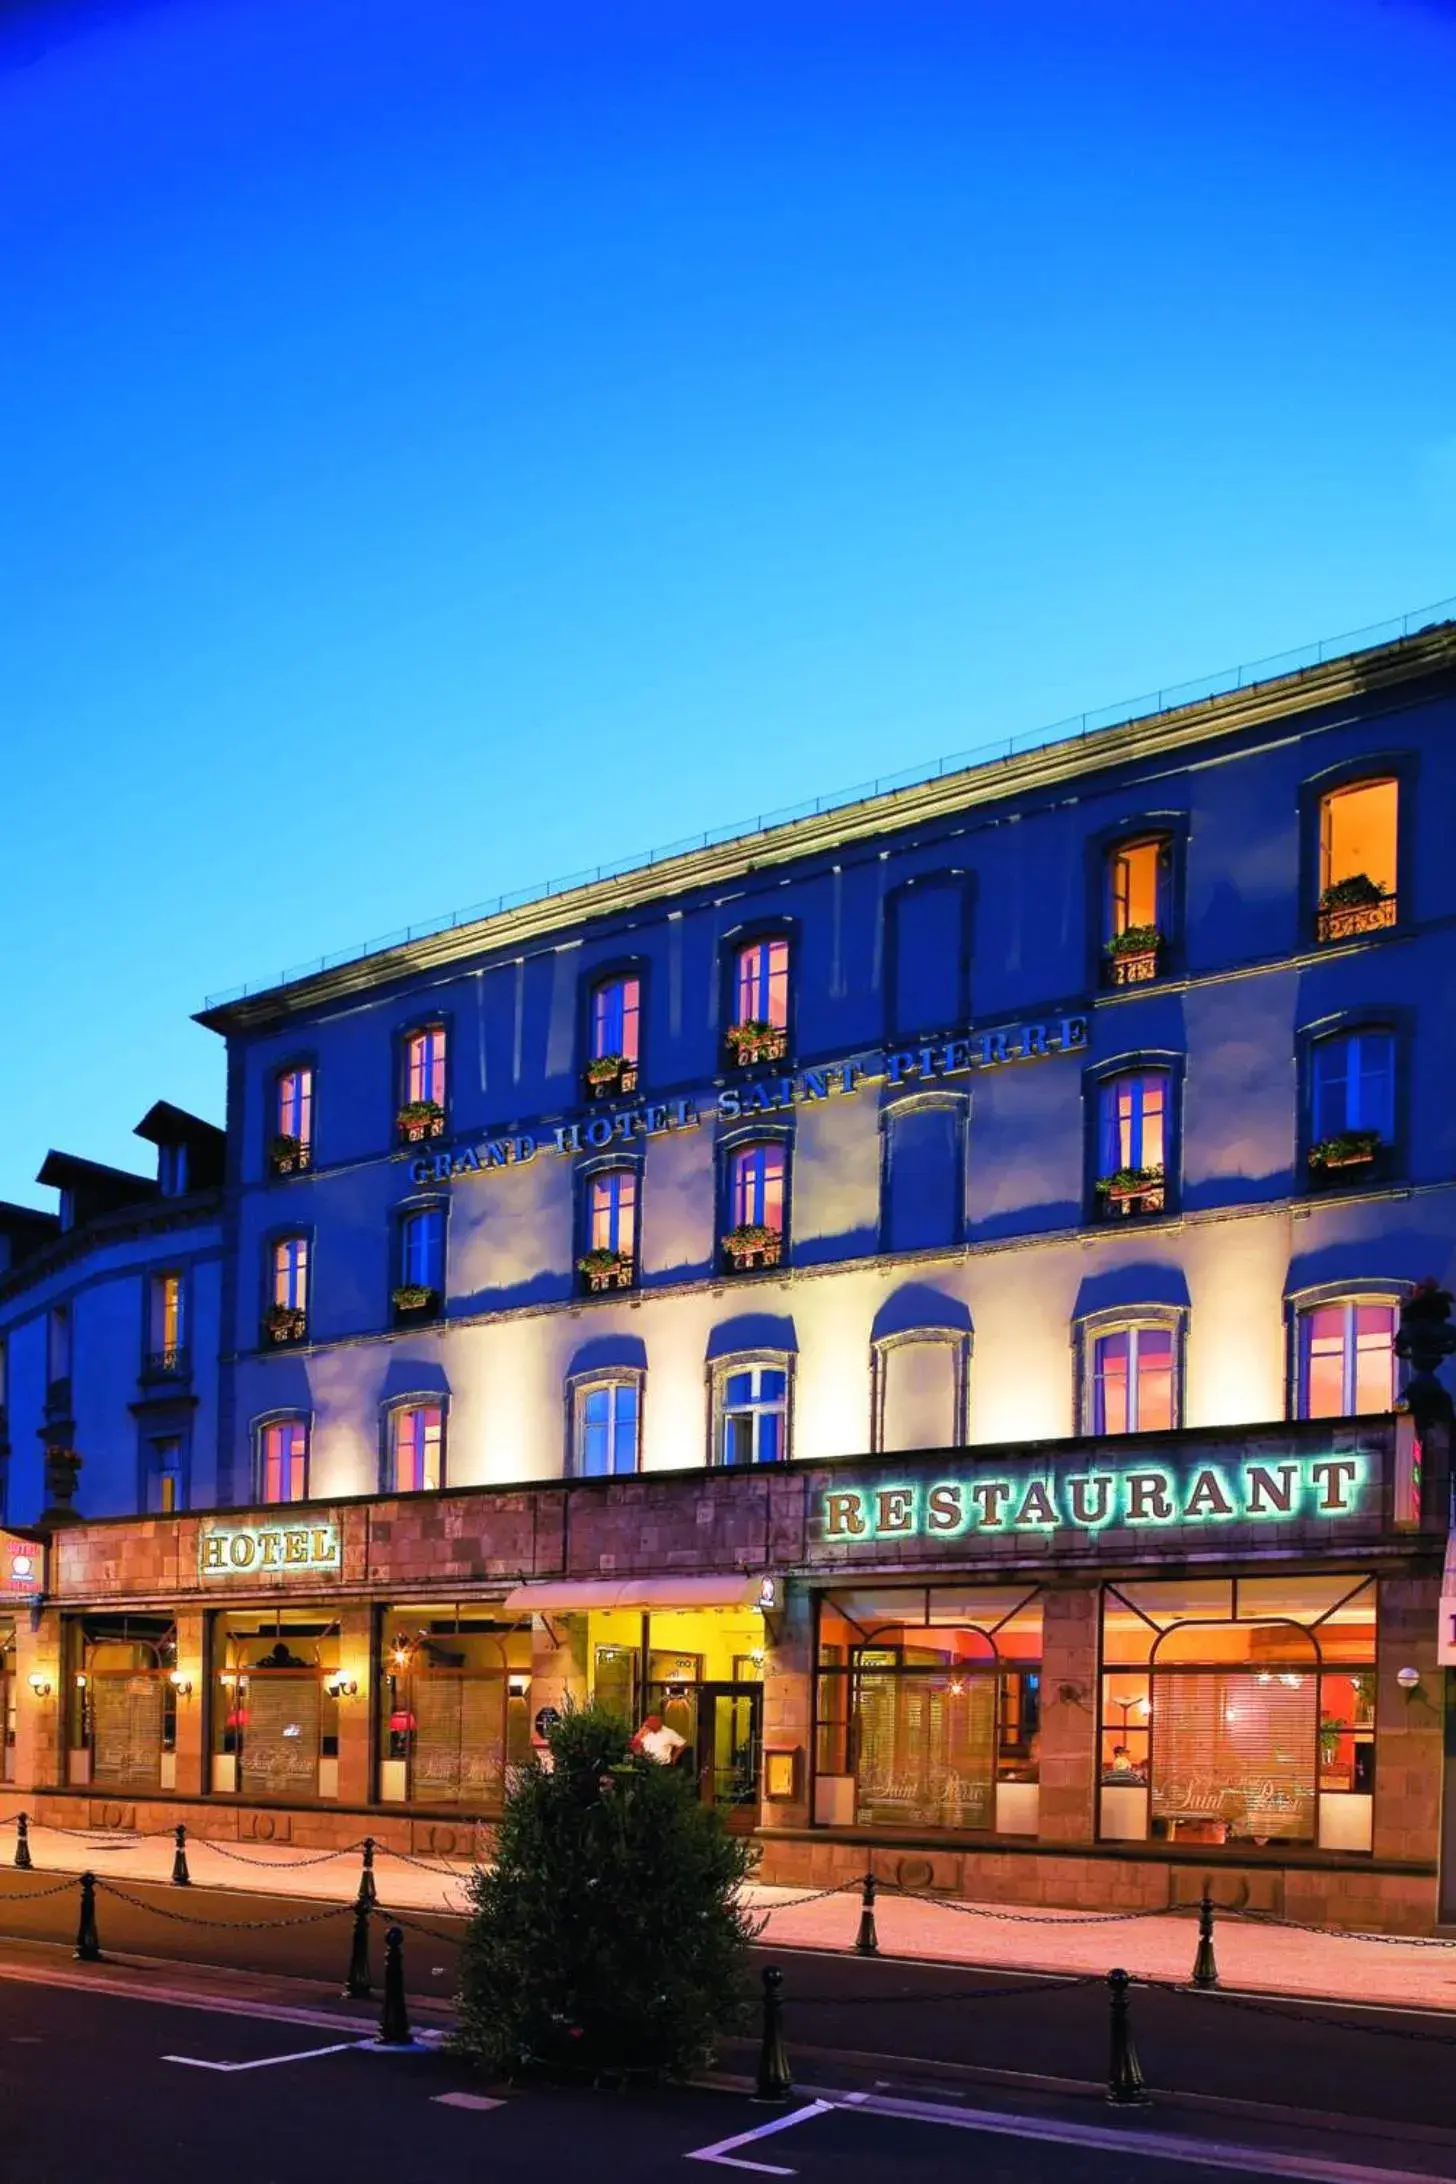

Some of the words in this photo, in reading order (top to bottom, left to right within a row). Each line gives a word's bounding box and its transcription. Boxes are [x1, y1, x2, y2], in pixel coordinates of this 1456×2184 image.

[409, 1134, 537, 1184] GRAND
[553, 1099, 699, 1157] HOTEL
[717, 1057, 866, 1122] SAINT
[885, 1015, 1089, 1087] PIERRE
[824, 1460, 1356, 1536] RESTAURANT
[201, 1529, 337, 1568] HOTEL
